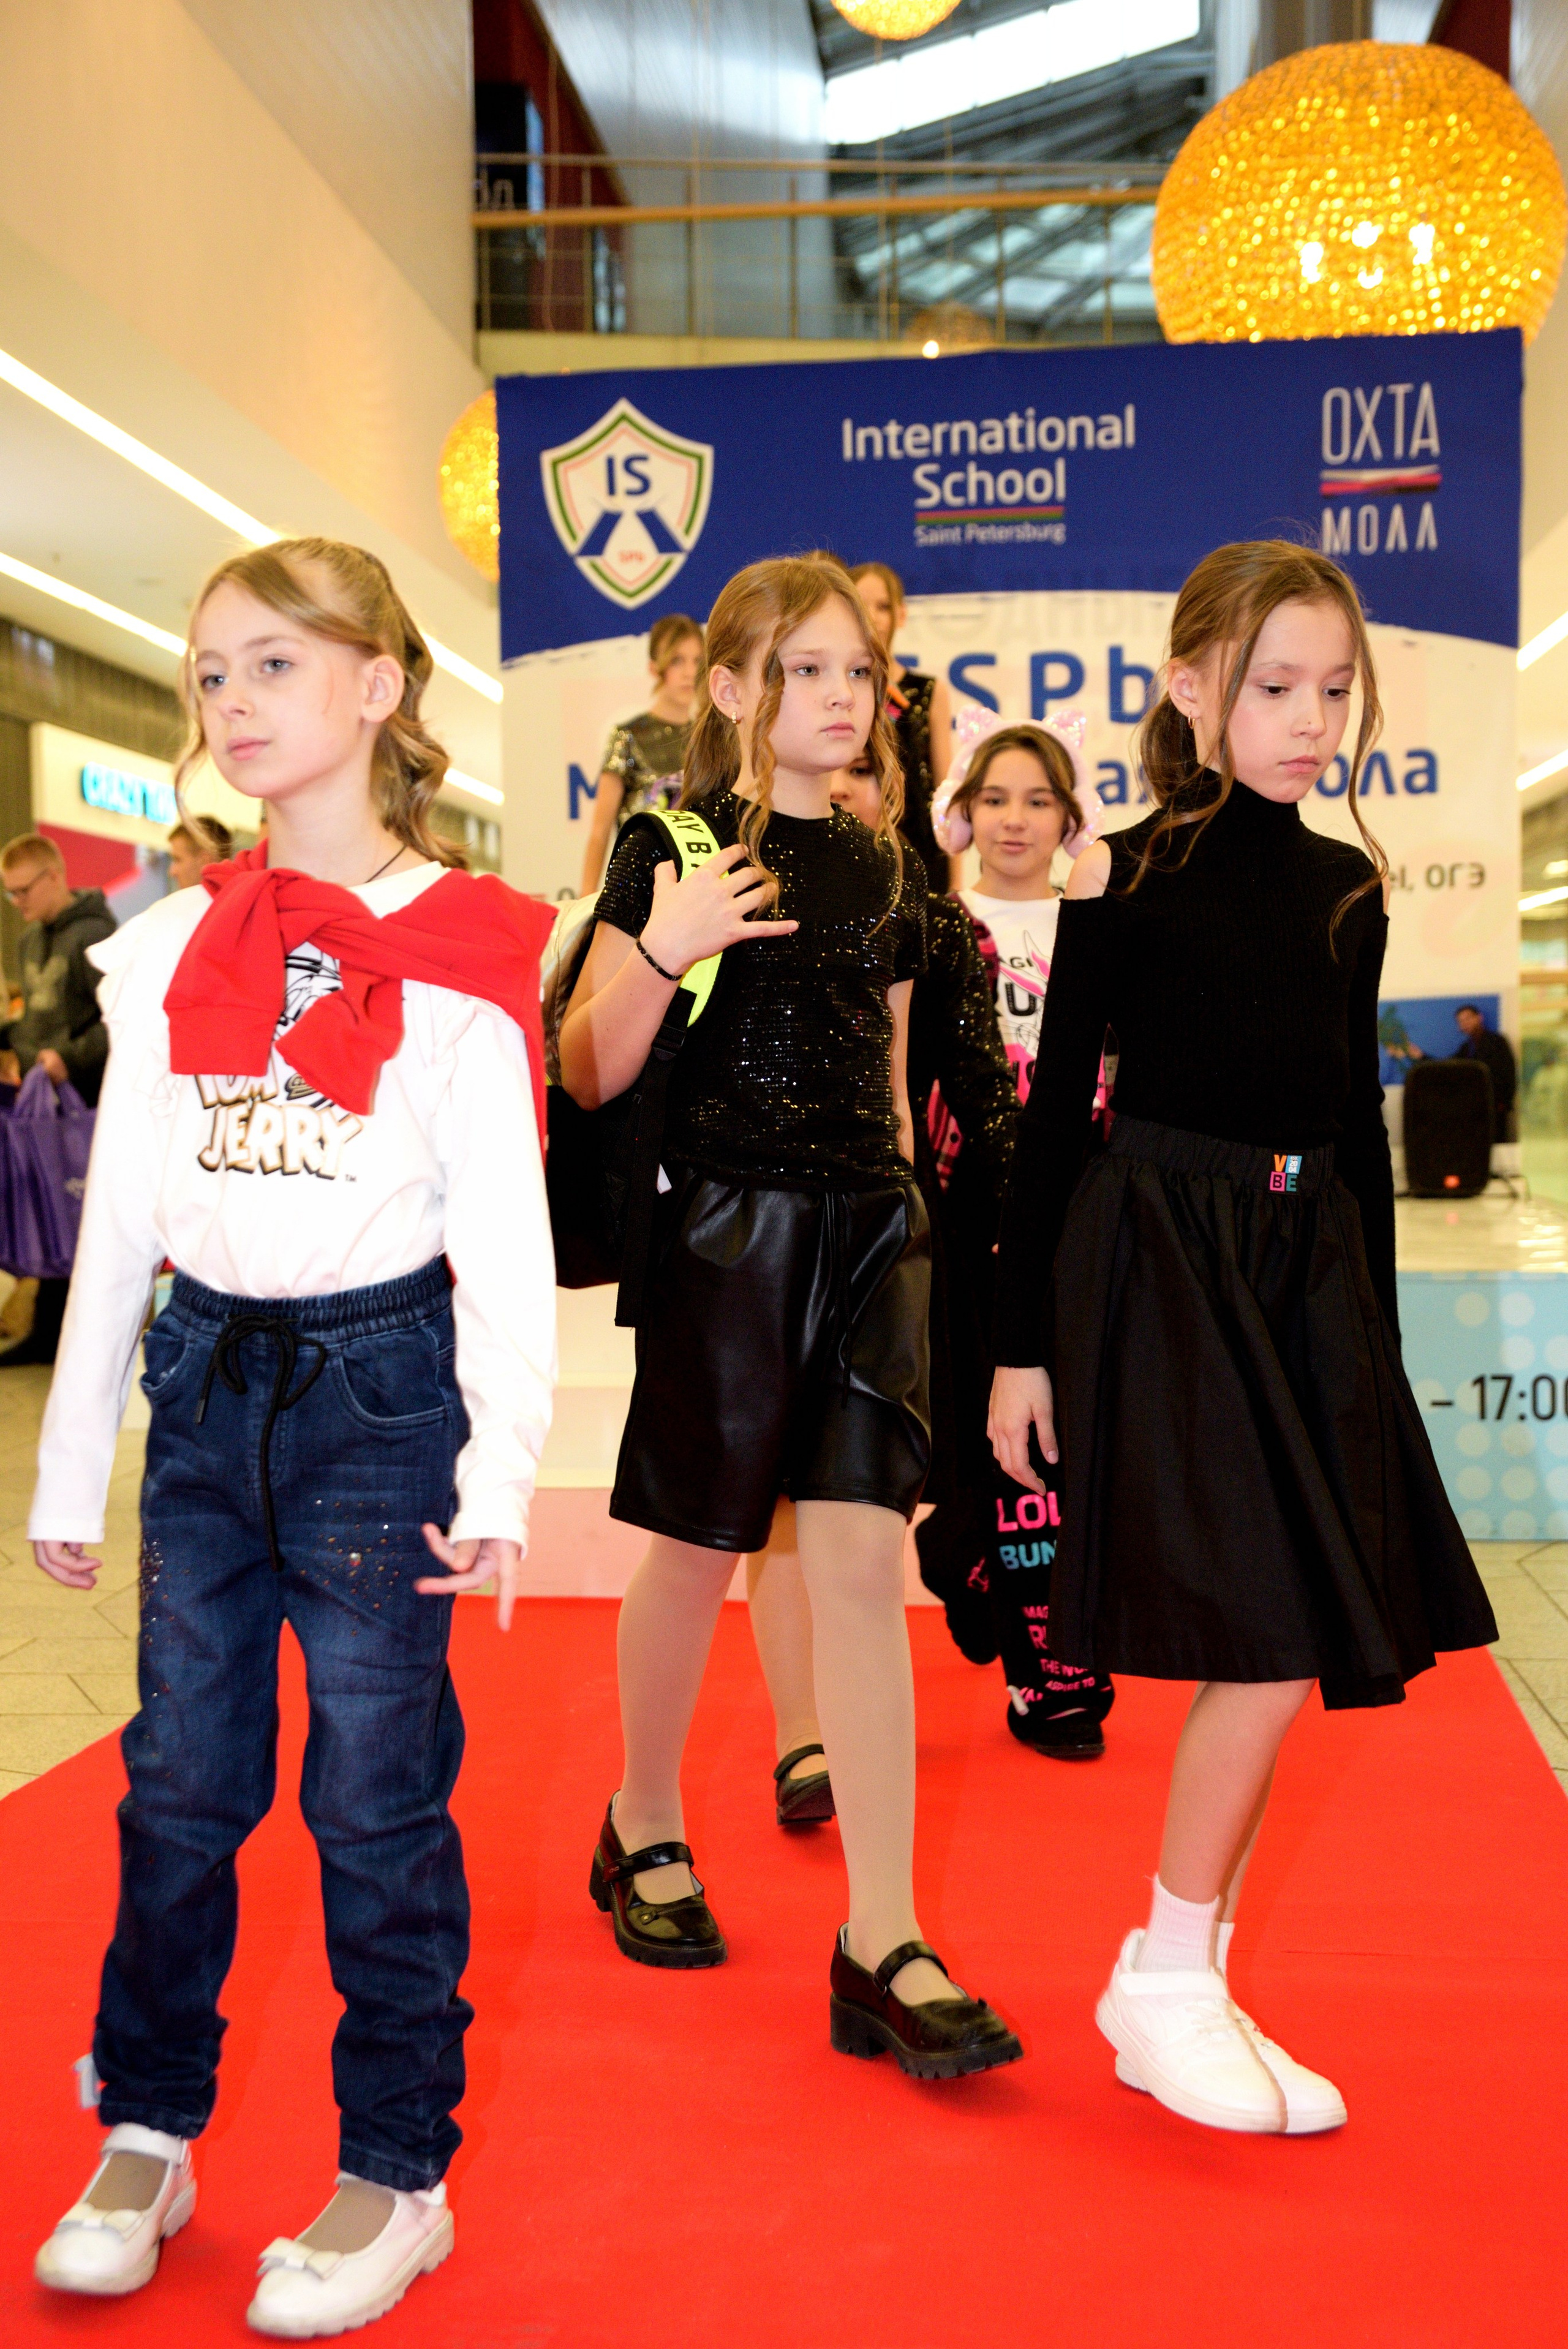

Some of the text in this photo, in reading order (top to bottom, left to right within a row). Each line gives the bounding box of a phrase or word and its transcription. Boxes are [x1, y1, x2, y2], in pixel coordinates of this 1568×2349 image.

[842, 402, 1136, 462] International
[1321, 381, 1441, 466] ОХТА
[606, 454, 652, 496] IS
[913, 457, 1066, 510] School
[914, 521, 1067, 548] Saint Petersburg
[1425, 862, 1486, 891] ОГЭ
[197, 1101, 364, 1180] JERRY
[1472, 1374, 1568, 1420] 17:0
[996, 1491, 1061, 1532] LOL
[999, 1540, 1056, 1570] BUN
